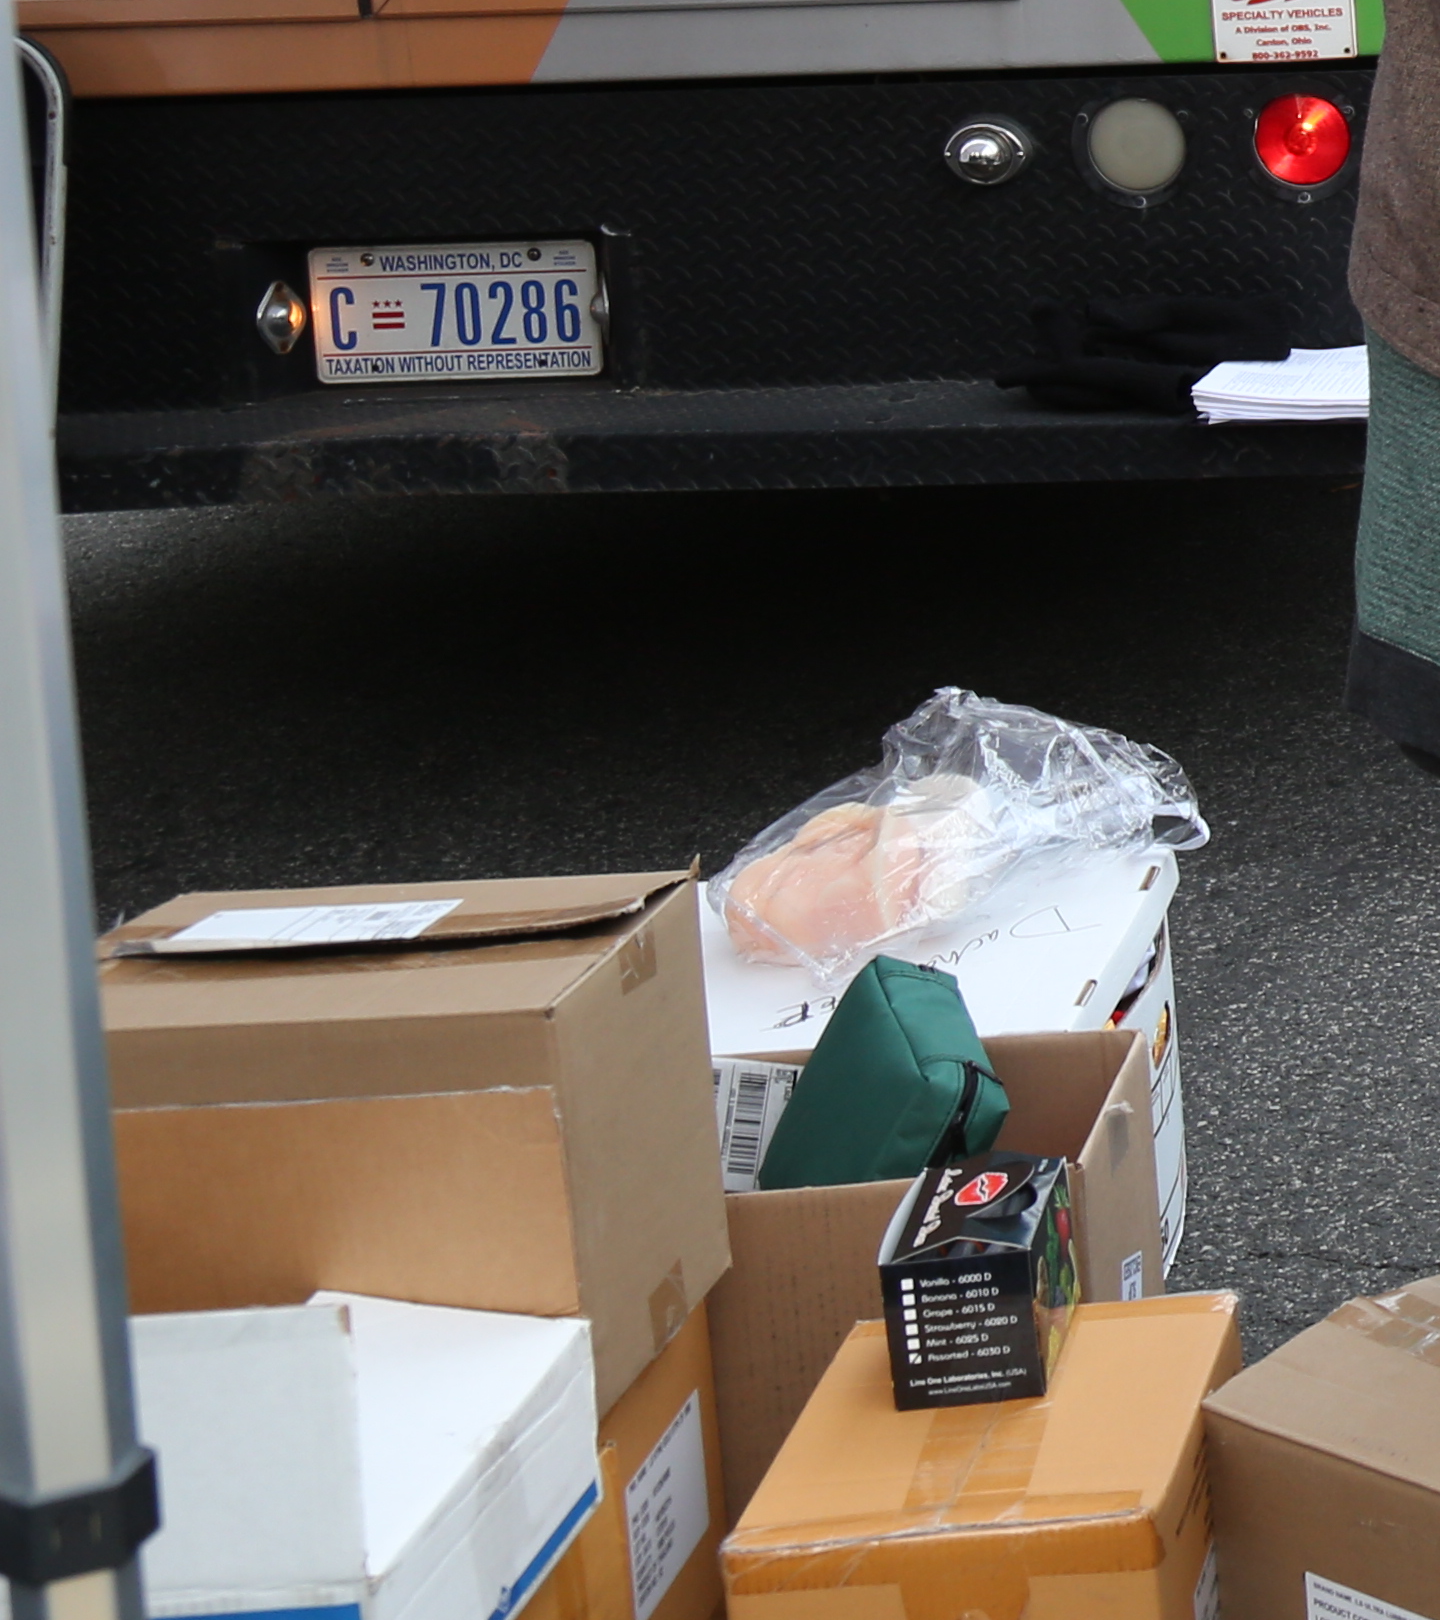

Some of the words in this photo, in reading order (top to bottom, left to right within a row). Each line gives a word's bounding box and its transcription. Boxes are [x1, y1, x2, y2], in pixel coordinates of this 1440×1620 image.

[1222, 10, 1284, 21] SPECIALTY
[1287, 8, 1343, 19] VEHICLES
[379, 252, 495, 272] WASHINGTON,
[500, 251, 522, 268] DC
[329, 287, 358, 350] C
[420, 279, 582, 347] 70286
[326, 357, 395, 375] TAXATION
[400, 355, 463, 373] WITHOUT
[467, 351, 592, 371] REPRESENTATION
[920, 1276, 950, 1288] Vanilla
[958, 1272, 982, 1285] 6000
[984, 1272, 992, 1281] D
[921, 1291, 958, 1303] Banana
[965, 1287, 990, 1300] 6010
[991, 1287, 999, 1296] D
[923, 1308, 954, 1319] Grape
[962, 1303, 985, 1315] 6015
[987, 1303, 996, 1311] D
[924, 1320, 977, 1334] Strawberry
[984, 1316, 1008, 1328] 6020
[1010, 1315, 1018, 1324] D
[926, 1337, 948, 1348] Mint
[955, 1333, 979, 1346] 6025
[981, 1333, 989, 1342] D
[927, 1349, 969, 1363] Assorted
[976, 1345, 1001, 1358] 6030
[1002, 1345, 1011, 1354] D
